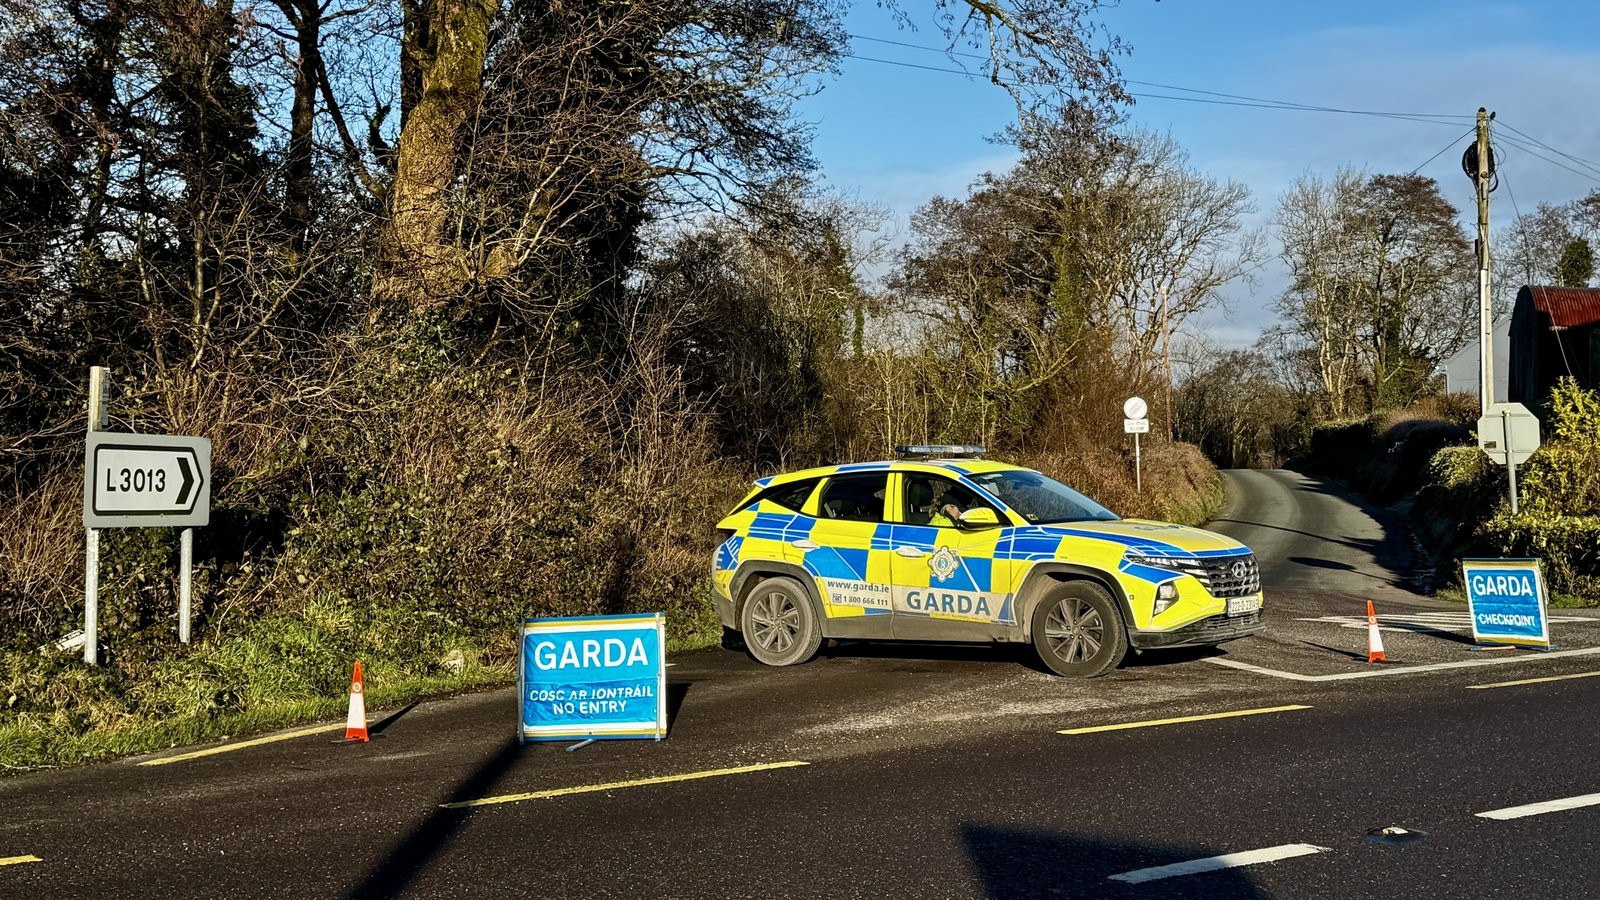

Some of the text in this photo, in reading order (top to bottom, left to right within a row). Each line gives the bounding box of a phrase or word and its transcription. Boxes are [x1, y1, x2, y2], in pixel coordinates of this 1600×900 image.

[106, 467, 166, 493] L3013
[827, 580, 890, 593] www.garda.ie
[1472, 575, 1533, 597] GARDA
[843, 595, 888, 606] 1 800 666 111
[906, 591, 991, 616] GARDA
[1478, 613, 1536, 627] CHECKPOINT
[534, 637, 649, 671] GARDA
[529, 684, 654, 702] COSC AR IONTRÁIL
[552, 700, 627, 715] NO ENTRY
